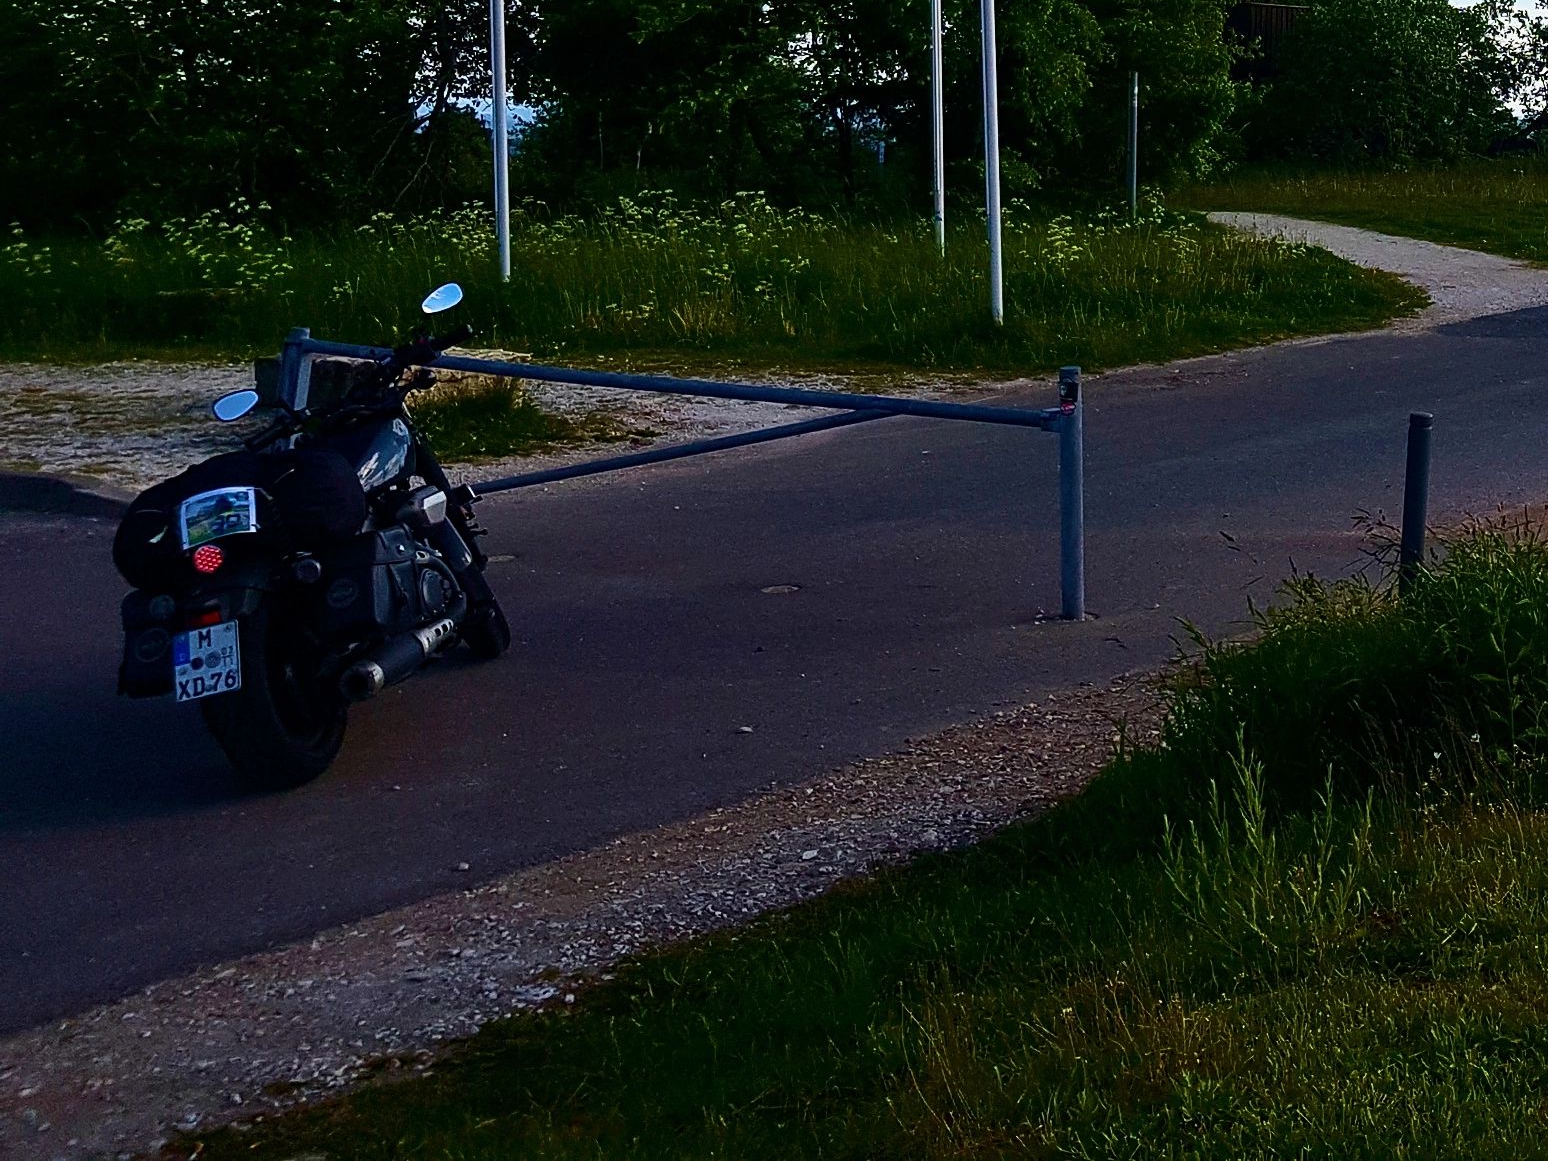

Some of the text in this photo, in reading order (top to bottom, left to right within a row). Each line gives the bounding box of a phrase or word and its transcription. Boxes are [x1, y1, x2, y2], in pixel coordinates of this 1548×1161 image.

[198, 628, 211, 649] M
[178, 670, 237, 700] XD 76
